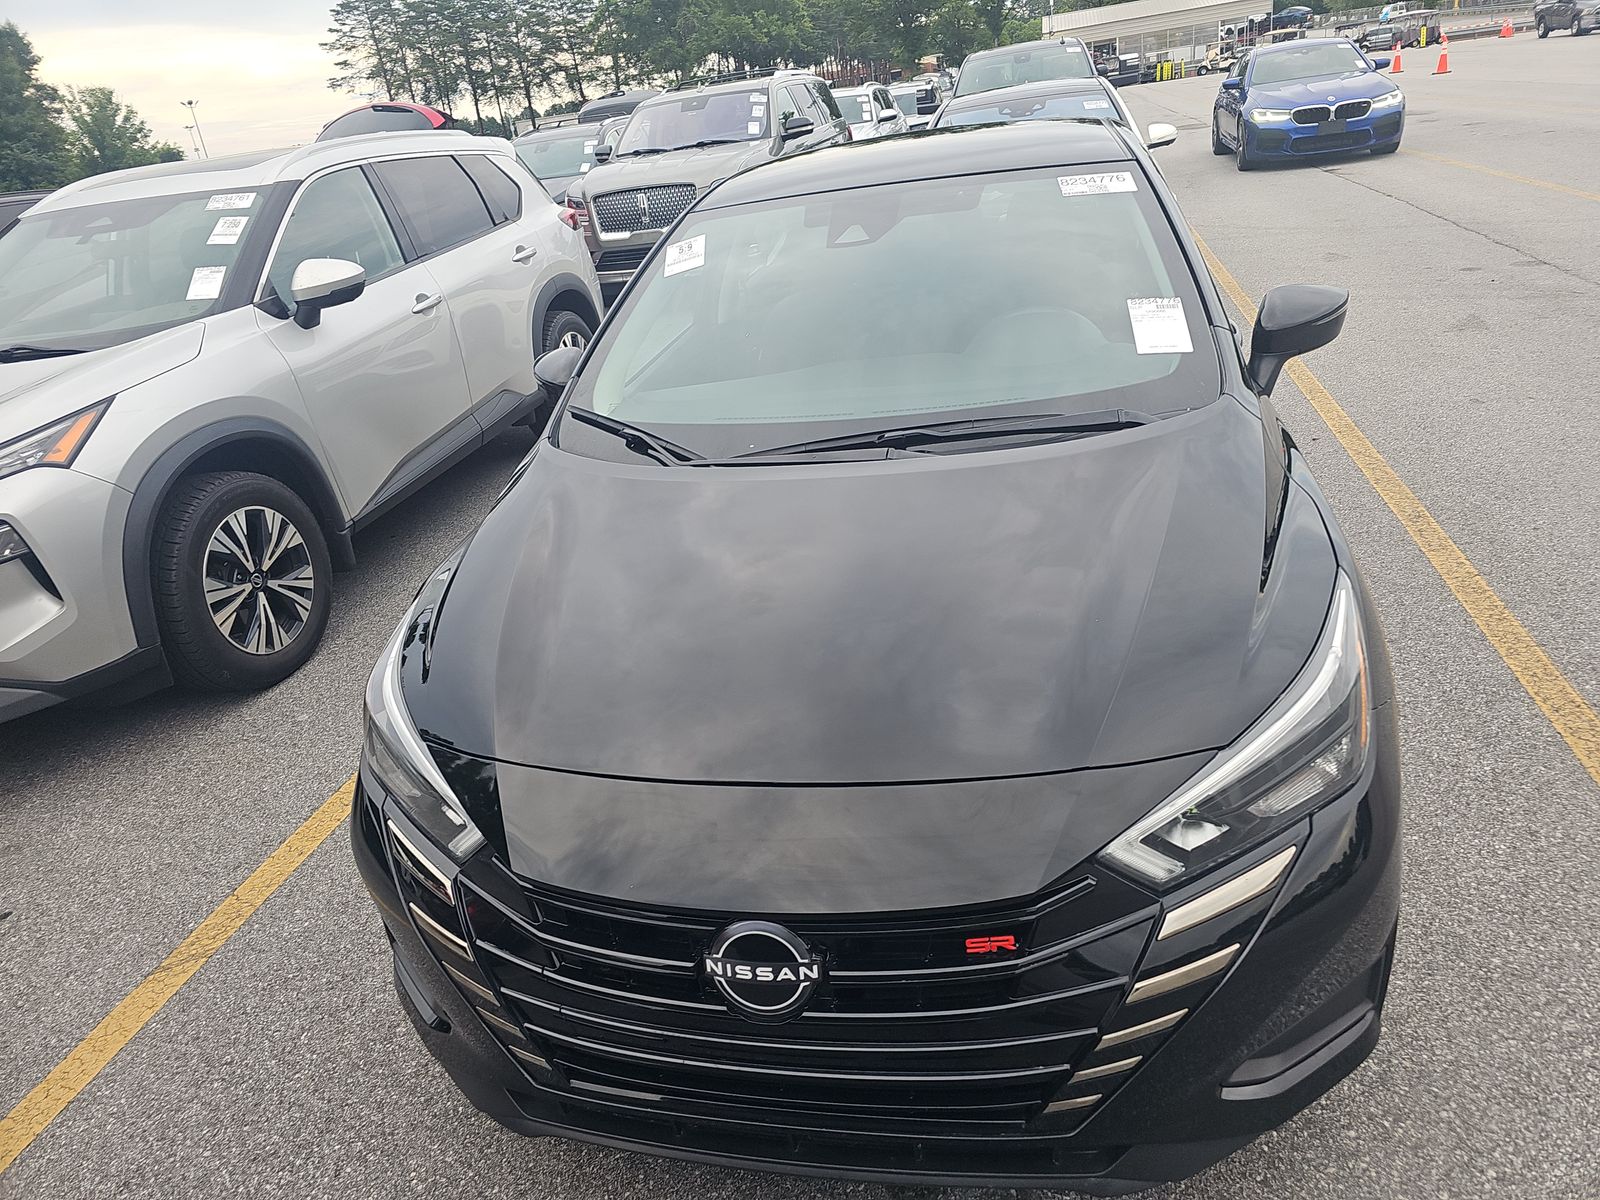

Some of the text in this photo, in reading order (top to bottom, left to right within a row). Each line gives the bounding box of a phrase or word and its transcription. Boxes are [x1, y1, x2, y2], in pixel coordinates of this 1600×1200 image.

[1060, 174, 1126, 187] 8234776
[210, 194, 250, 203] 8234761
[965, 935, 1016, 954] SR
[705, 957, 819, 982] NISSAN
